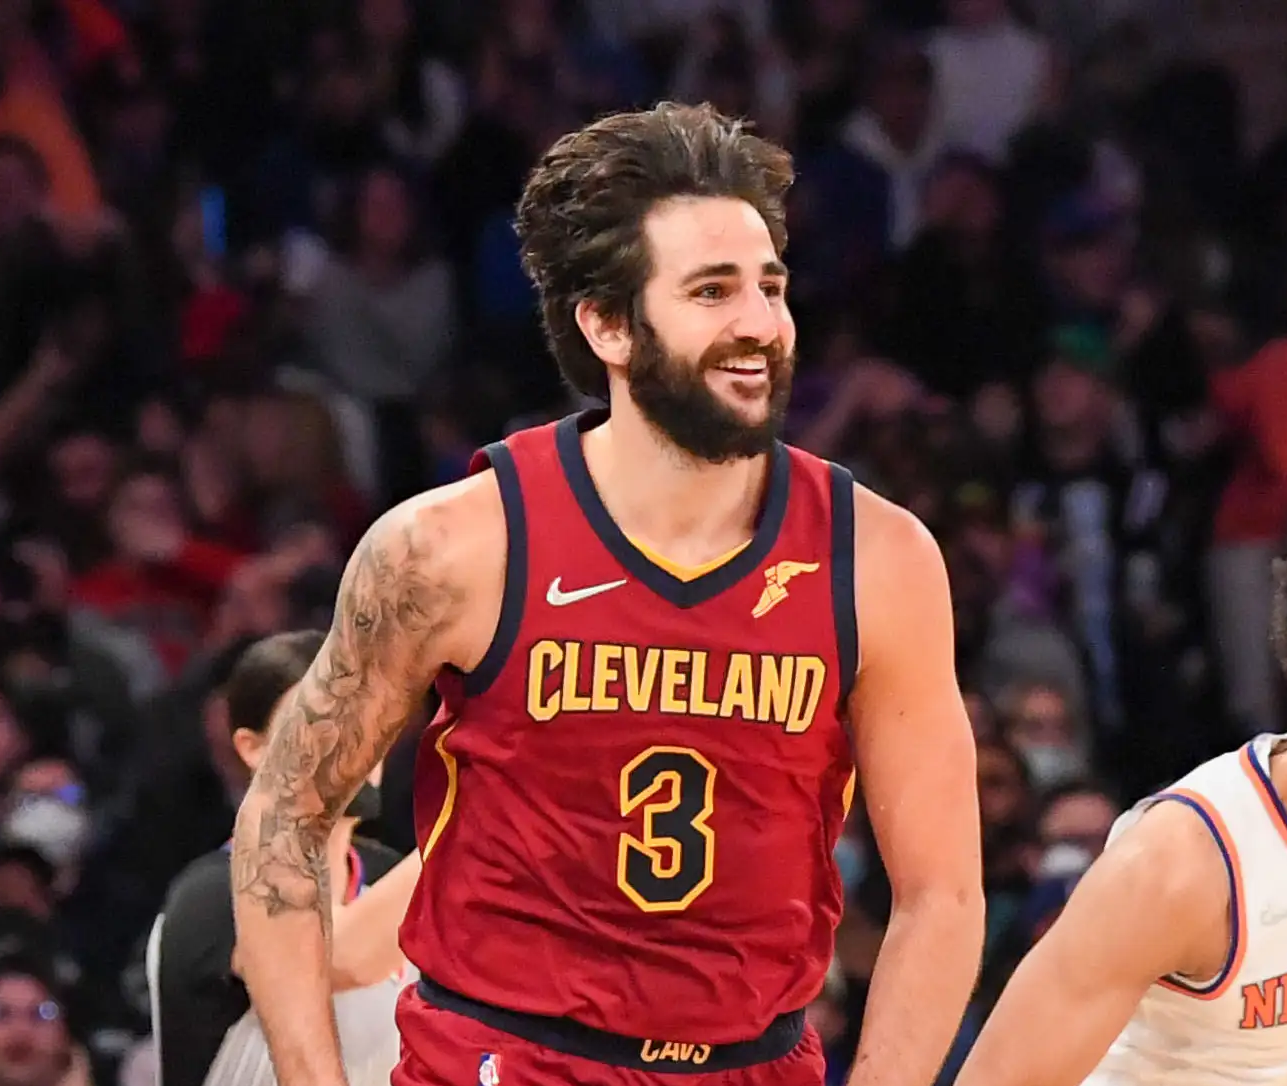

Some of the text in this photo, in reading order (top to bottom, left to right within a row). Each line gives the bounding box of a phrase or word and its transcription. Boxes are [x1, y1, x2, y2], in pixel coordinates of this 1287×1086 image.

[525, 637, 827, 735] CLEVELAND
[617, 745, 717, 913] 3
[640, 1039, 712, 1065] CAVS
